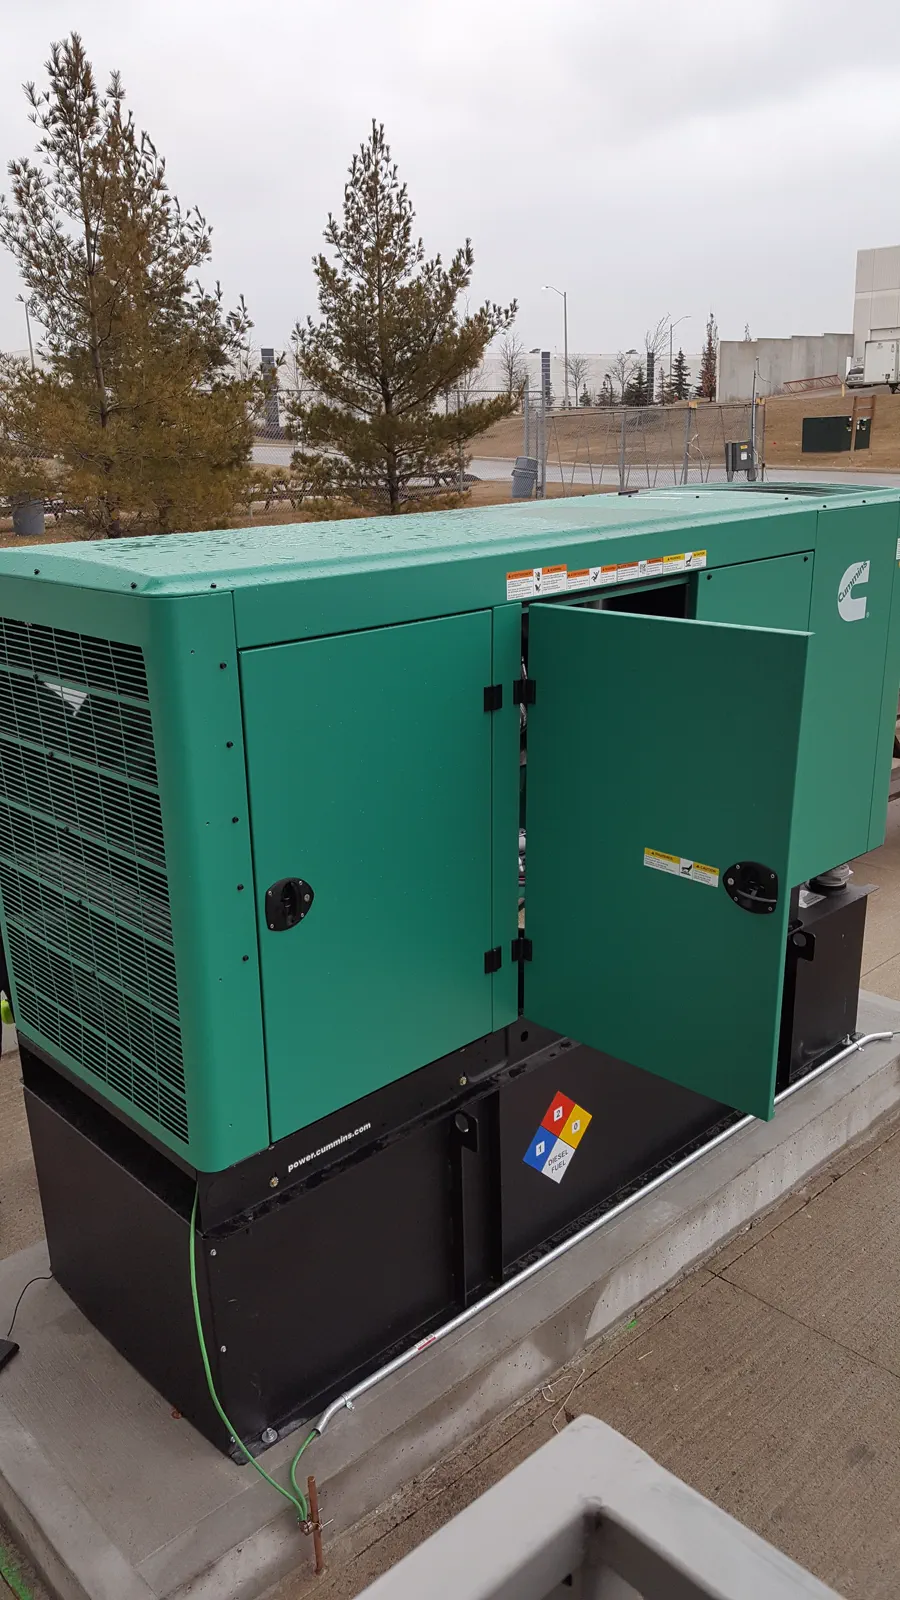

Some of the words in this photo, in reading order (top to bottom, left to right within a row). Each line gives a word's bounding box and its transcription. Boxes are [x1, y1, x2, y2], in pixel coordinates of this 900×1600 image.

[838, 562, 868, 603] Cummins
[287, 1122, 372, 1173] power.cummins.com
[548, 1149, 569, 1166] DIESEL
[551, 1160, 567, 1174] FUEL
